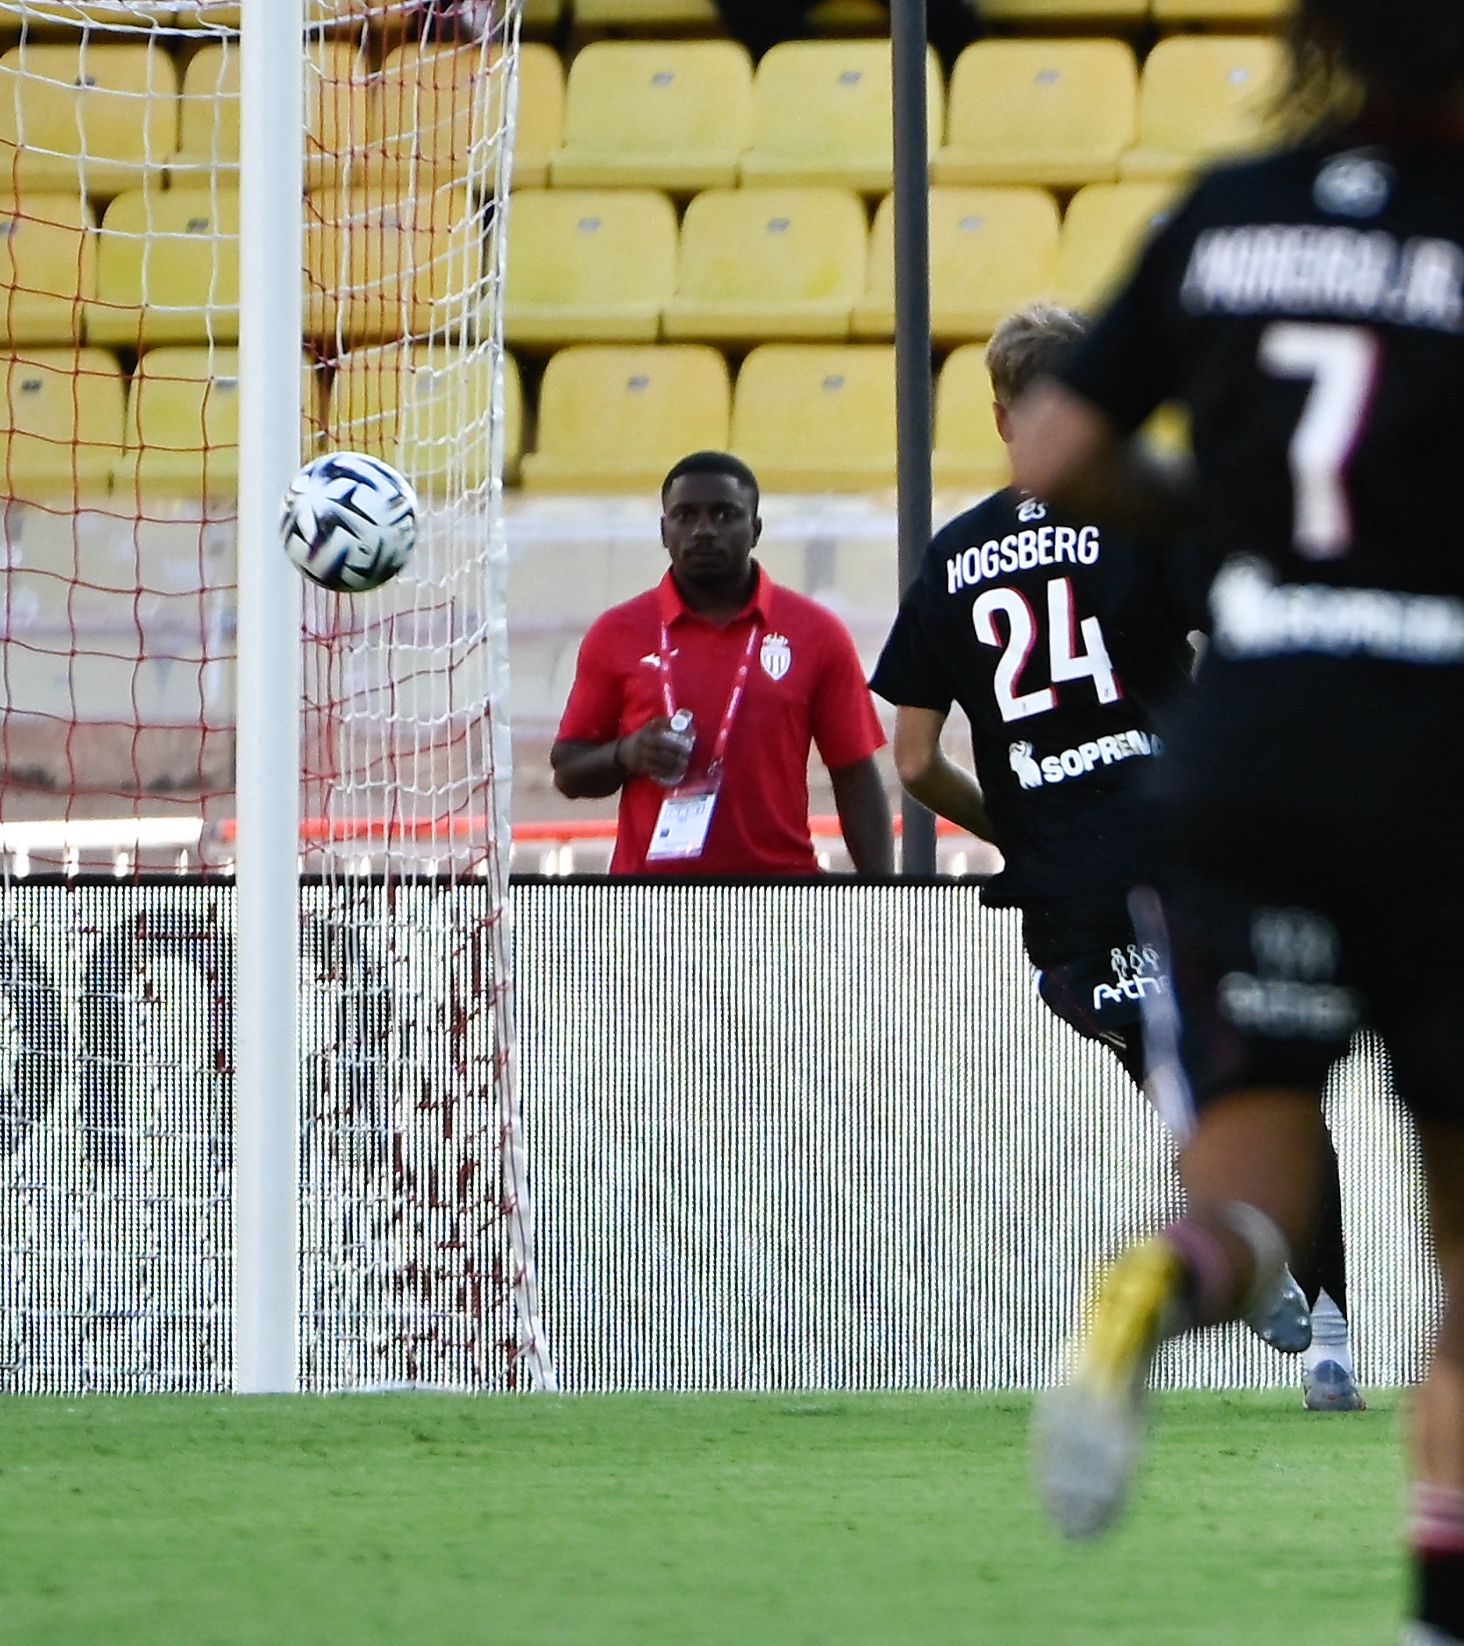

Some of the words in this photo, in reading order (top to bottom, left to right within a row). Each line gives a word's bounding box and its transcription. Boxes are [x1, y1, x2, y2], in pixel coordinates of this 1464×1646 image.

[1260, 321, 1380, 558] 7
[947, 526, 1100, 593] HOGSBERG
[972, 577, 1124, 722] 24
